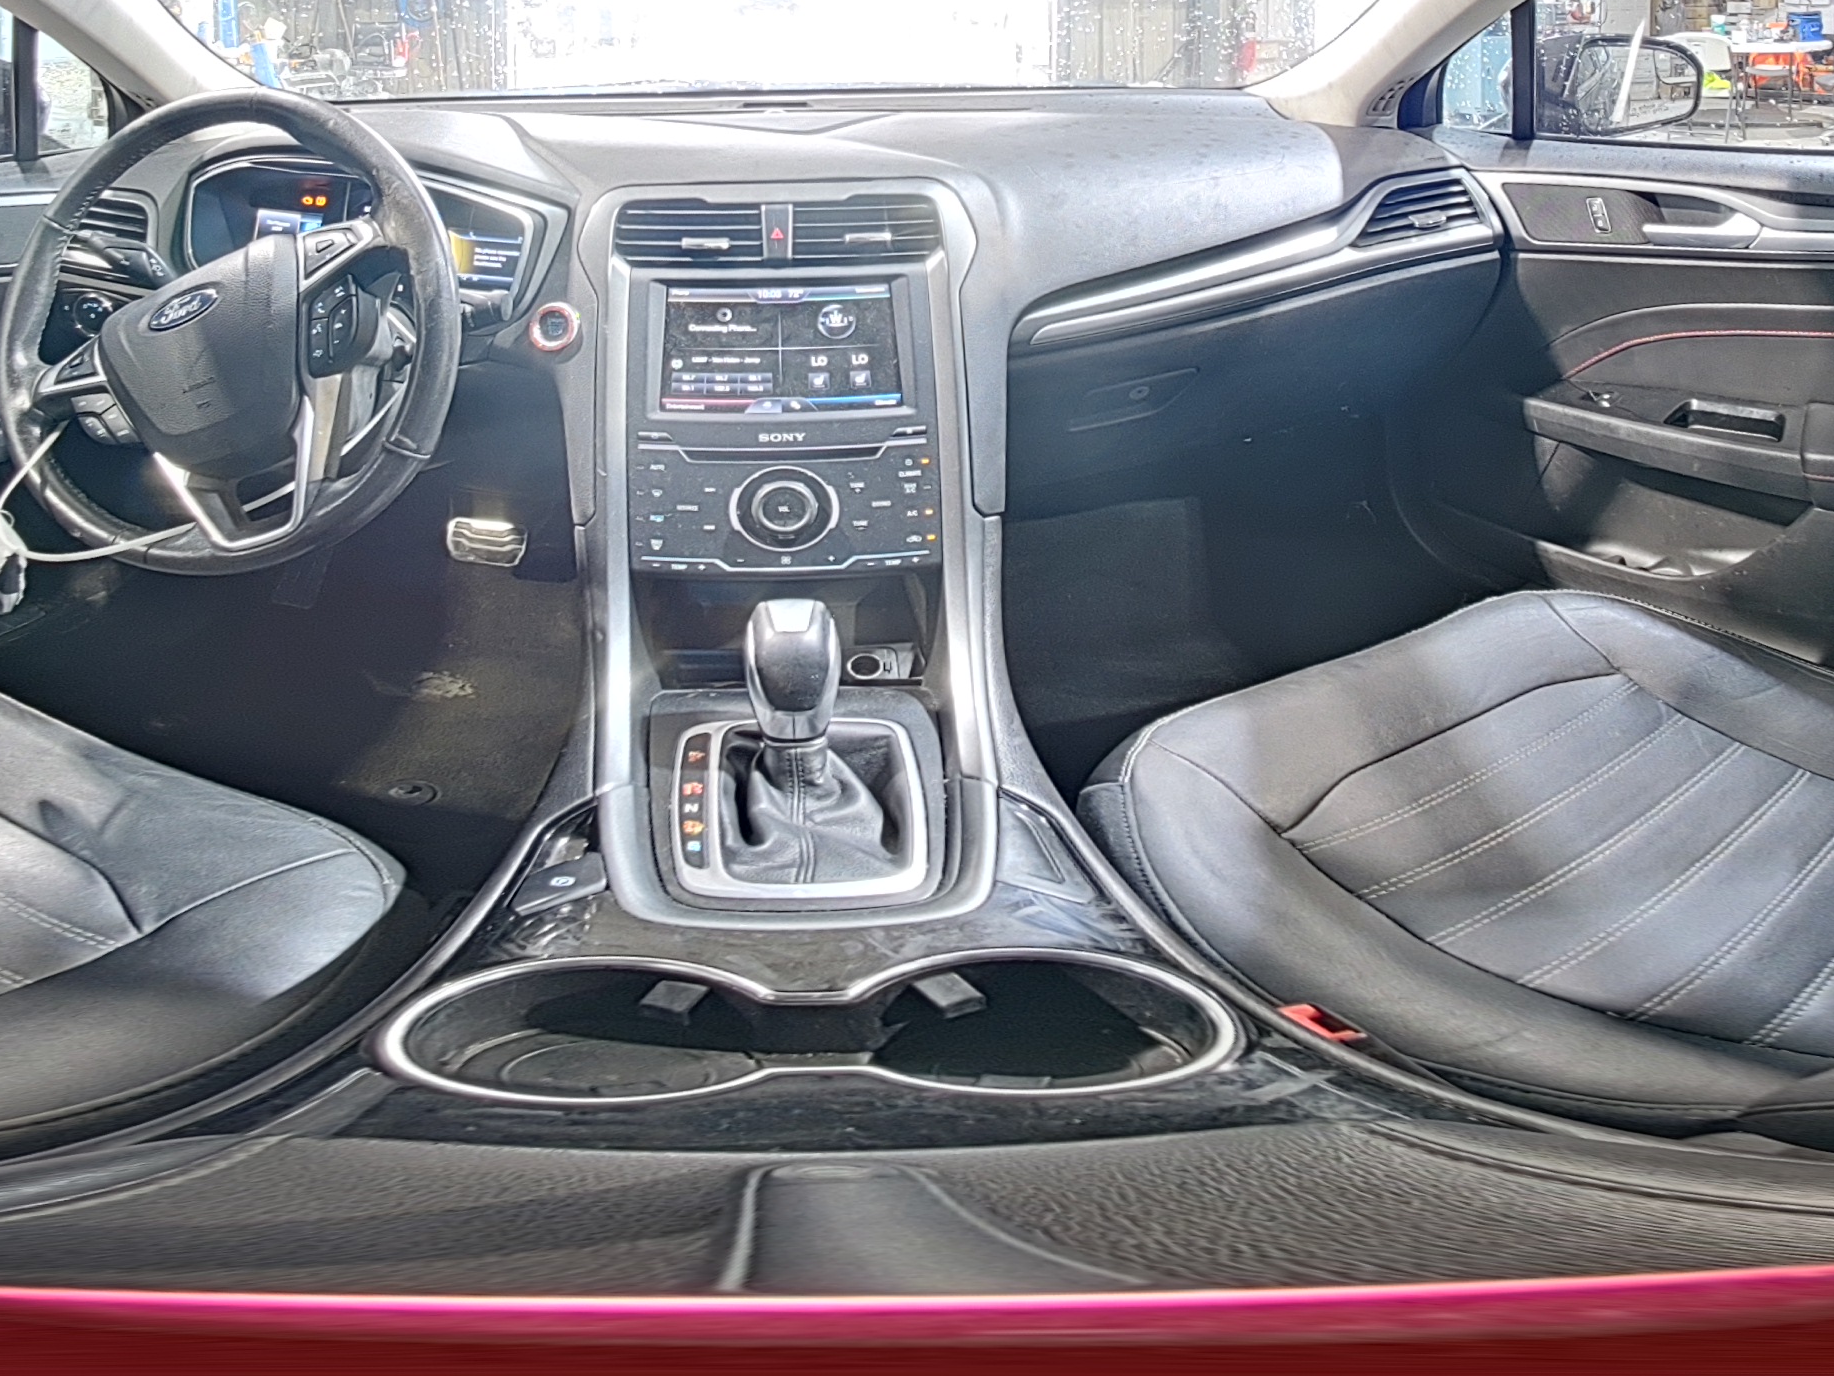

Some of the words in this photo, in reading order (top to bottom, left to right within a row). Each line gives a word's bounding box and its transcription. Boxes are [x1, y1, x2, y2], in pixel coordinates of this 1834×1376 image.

[160, 295, 202, 323] Ford
[811, 356, 828, 366] LO
[851, 354, 869, 364] LO
[758, 432, 806, 442] SONY
